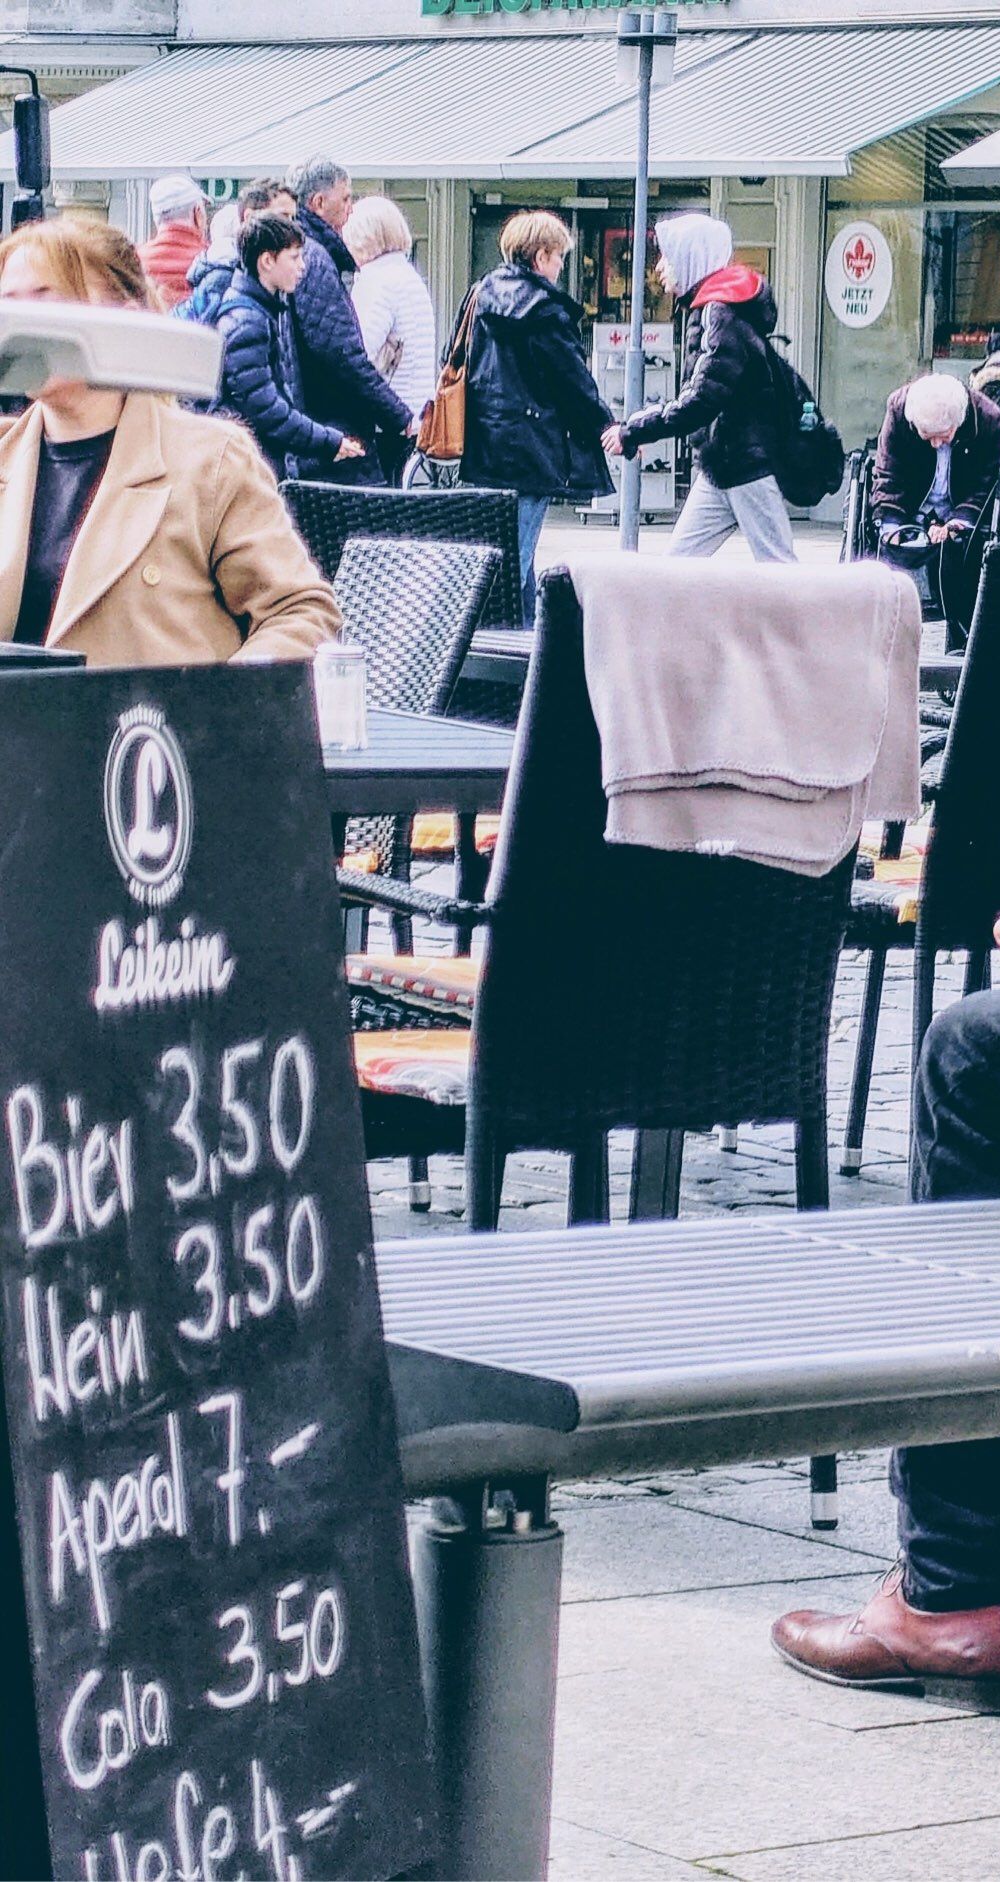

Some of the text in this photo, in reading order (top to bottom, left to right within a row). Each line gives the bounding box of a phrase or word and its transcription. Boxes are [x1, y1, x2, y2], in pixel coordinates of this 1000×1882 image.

[842, 287, 873, 300] JETZT
[846, 303, 868, 315] NEU
[7, 1034, 314, 1249] Bier 3,50
[23, 1196, 324, 1421] Wein 3,50
[49, 1411, 187, 1630] Aperol
[60, 1580, 342, 1790] Cola 3,50
